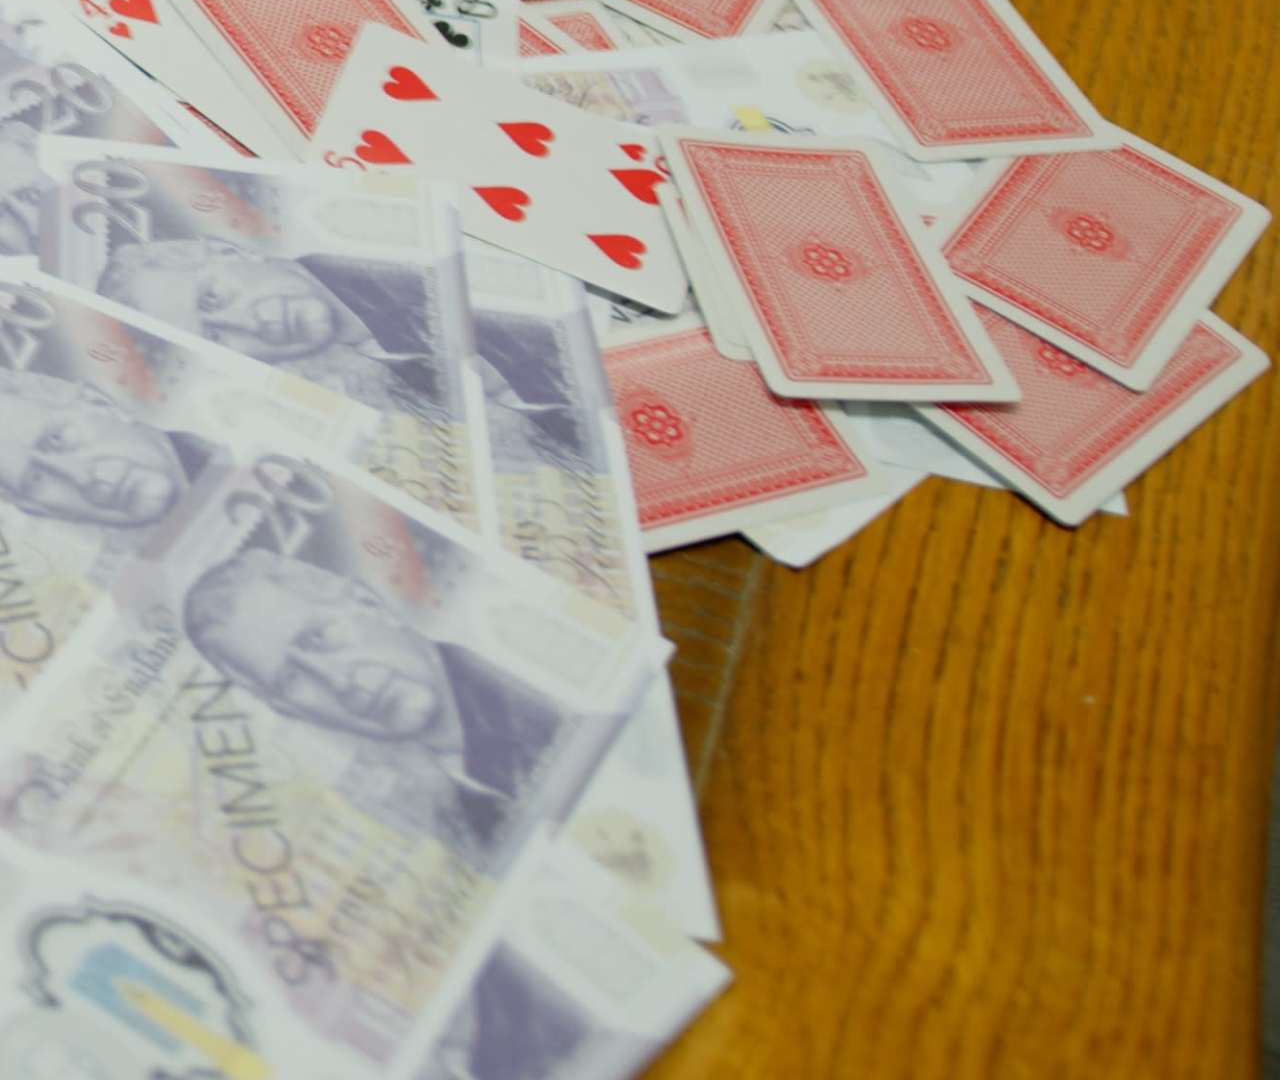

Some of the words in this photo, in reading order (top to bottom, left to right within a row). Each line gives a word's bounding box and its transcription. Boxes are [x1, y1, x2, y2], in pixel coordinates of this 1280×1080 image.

[72, 158, 152, 244] 20
[225, 453, 335, 560] 20
[179, 670, 338, 987] SPECIMEN
